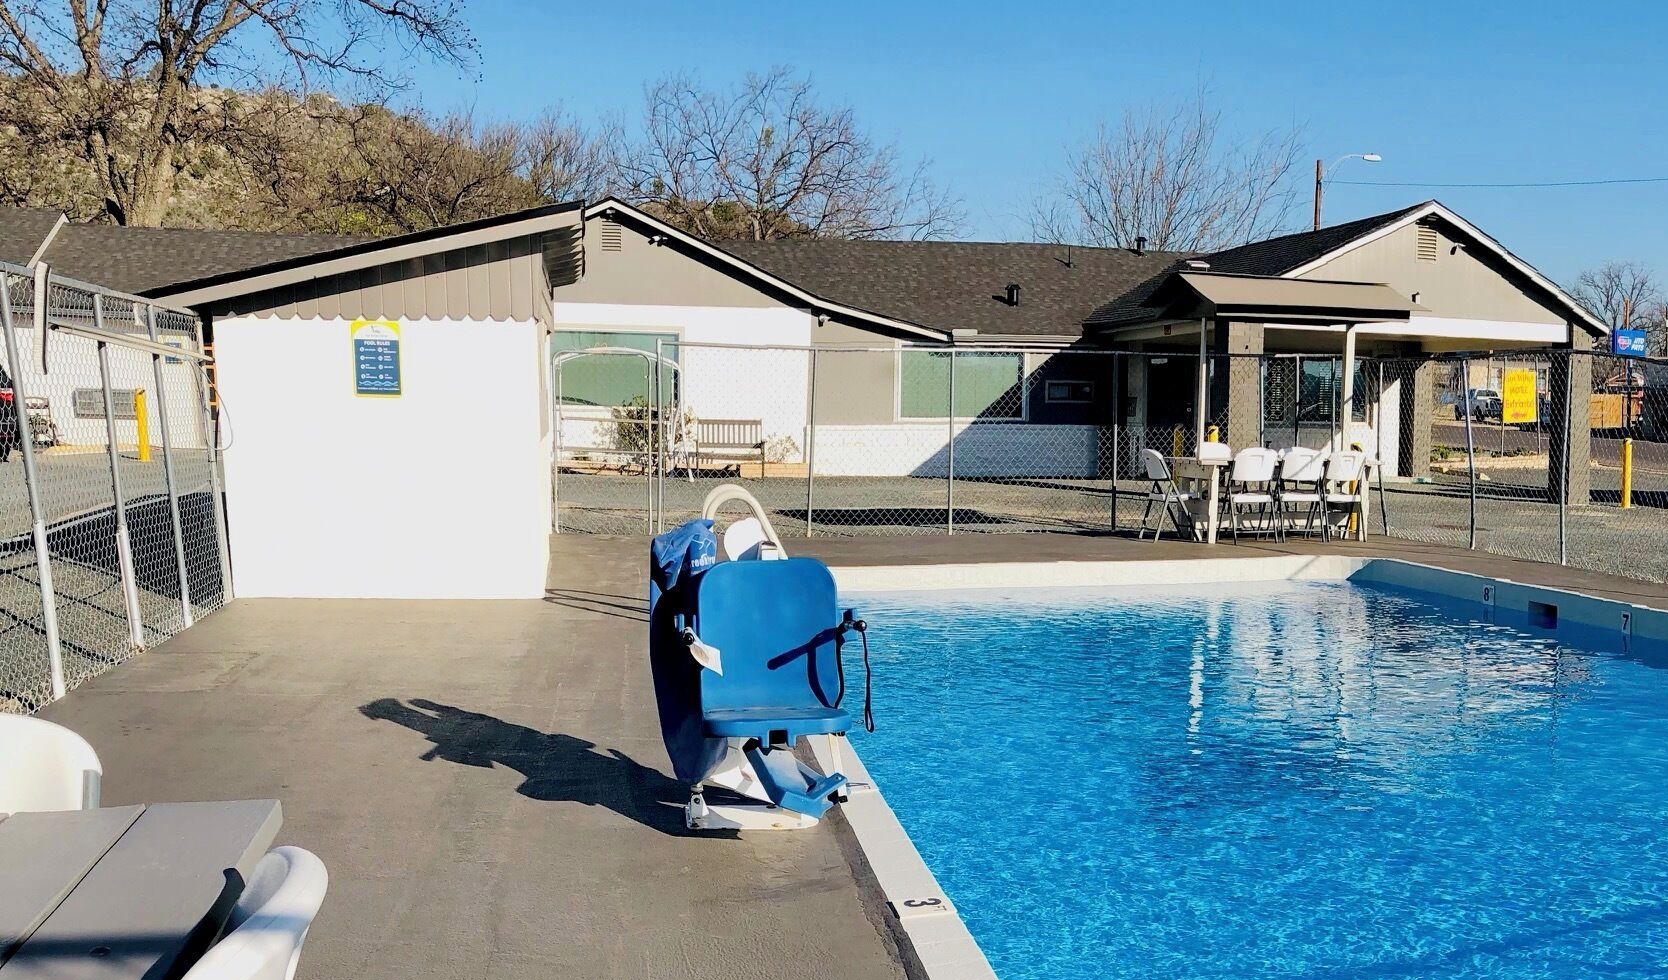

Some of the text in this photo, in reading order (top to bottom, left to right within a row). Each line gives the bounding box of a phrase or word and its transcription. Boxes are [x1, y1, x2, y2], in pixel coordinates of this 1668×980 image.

[1483, 586, 1490, 602] 8
[1622, 613, 1630, 630] 7
[903, 898, 942, 907] 3
